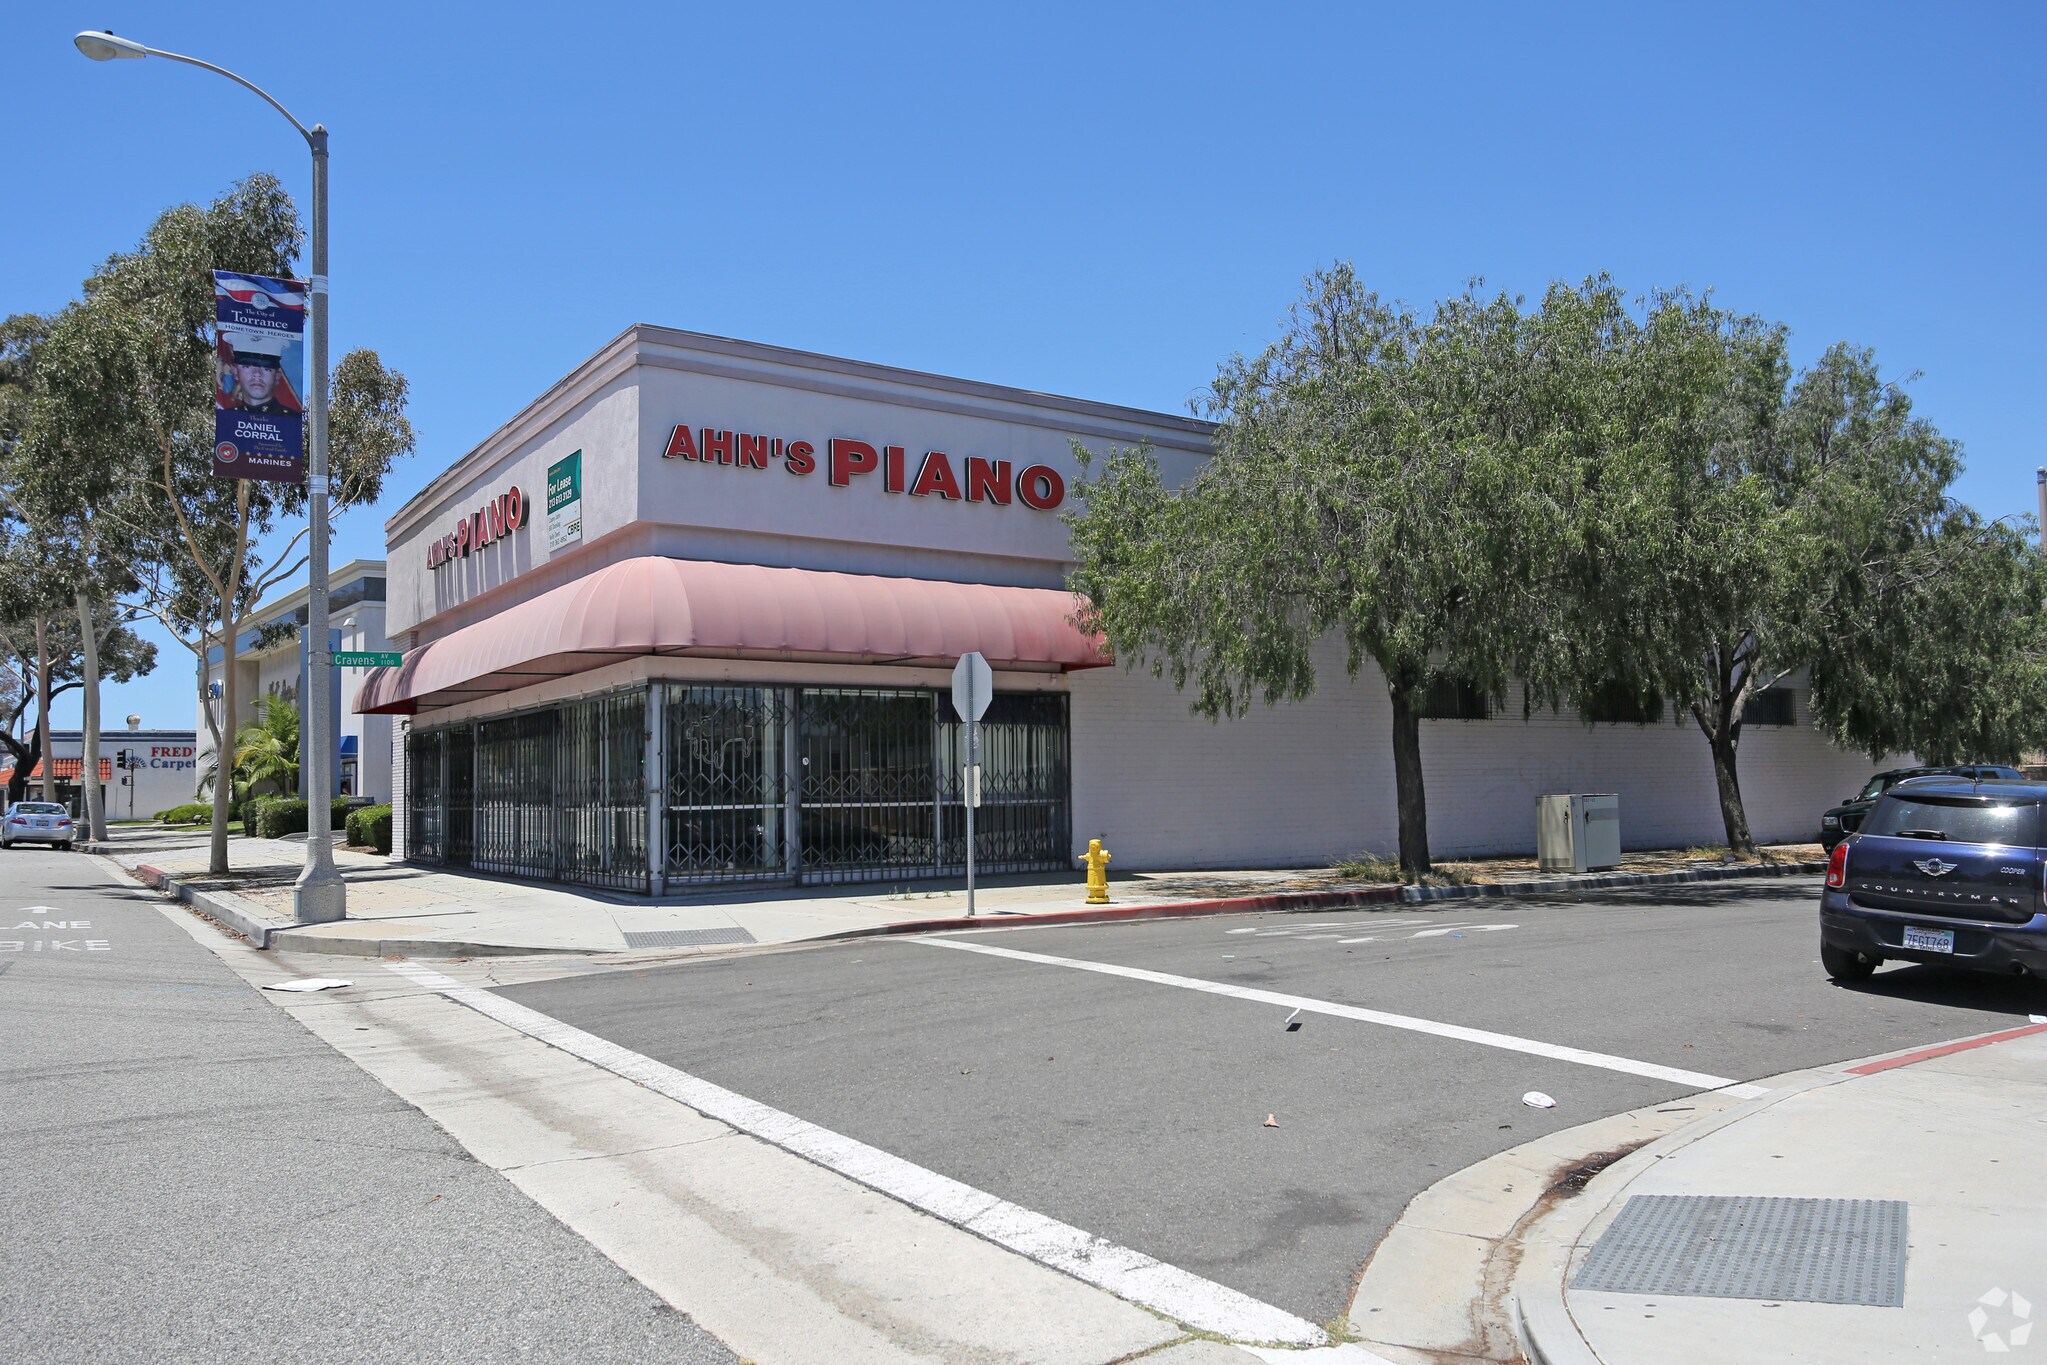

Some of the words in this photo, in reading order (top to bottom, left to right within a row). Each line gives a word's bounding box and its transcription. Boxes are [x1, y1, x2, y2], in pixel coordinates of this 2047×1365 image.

[231, 310, 289, 329] Torrance
[224, 324, 264, 335] HOMETOWN
[267, 331, 295, 339] HEROES
[237, 421, 281, 433] DANIEL
[234, 429, 284, 442] CORRAL
[248, 457, 292, 467] MARINES
[663, 423, 816, 476] AHN'S
[828, 436, 1066, 512] PIANO
[548, 483, 557, 497] For
[556, 475, 572, 492] Lease
[427, 531, 456, 570] AHN'S
[457, 485, 526, 559] PIANO
[567, 521, 580, 536] CBRE
[335, 654, 375, 665] Cravens
[150, 758, 196, 771] Carpet
[2001, 866, 2026, 875] COOPER
[1862, 884, 2018, 904] COUNTRYMAN
[1906, 933, 1949, 950] 7FGT768
